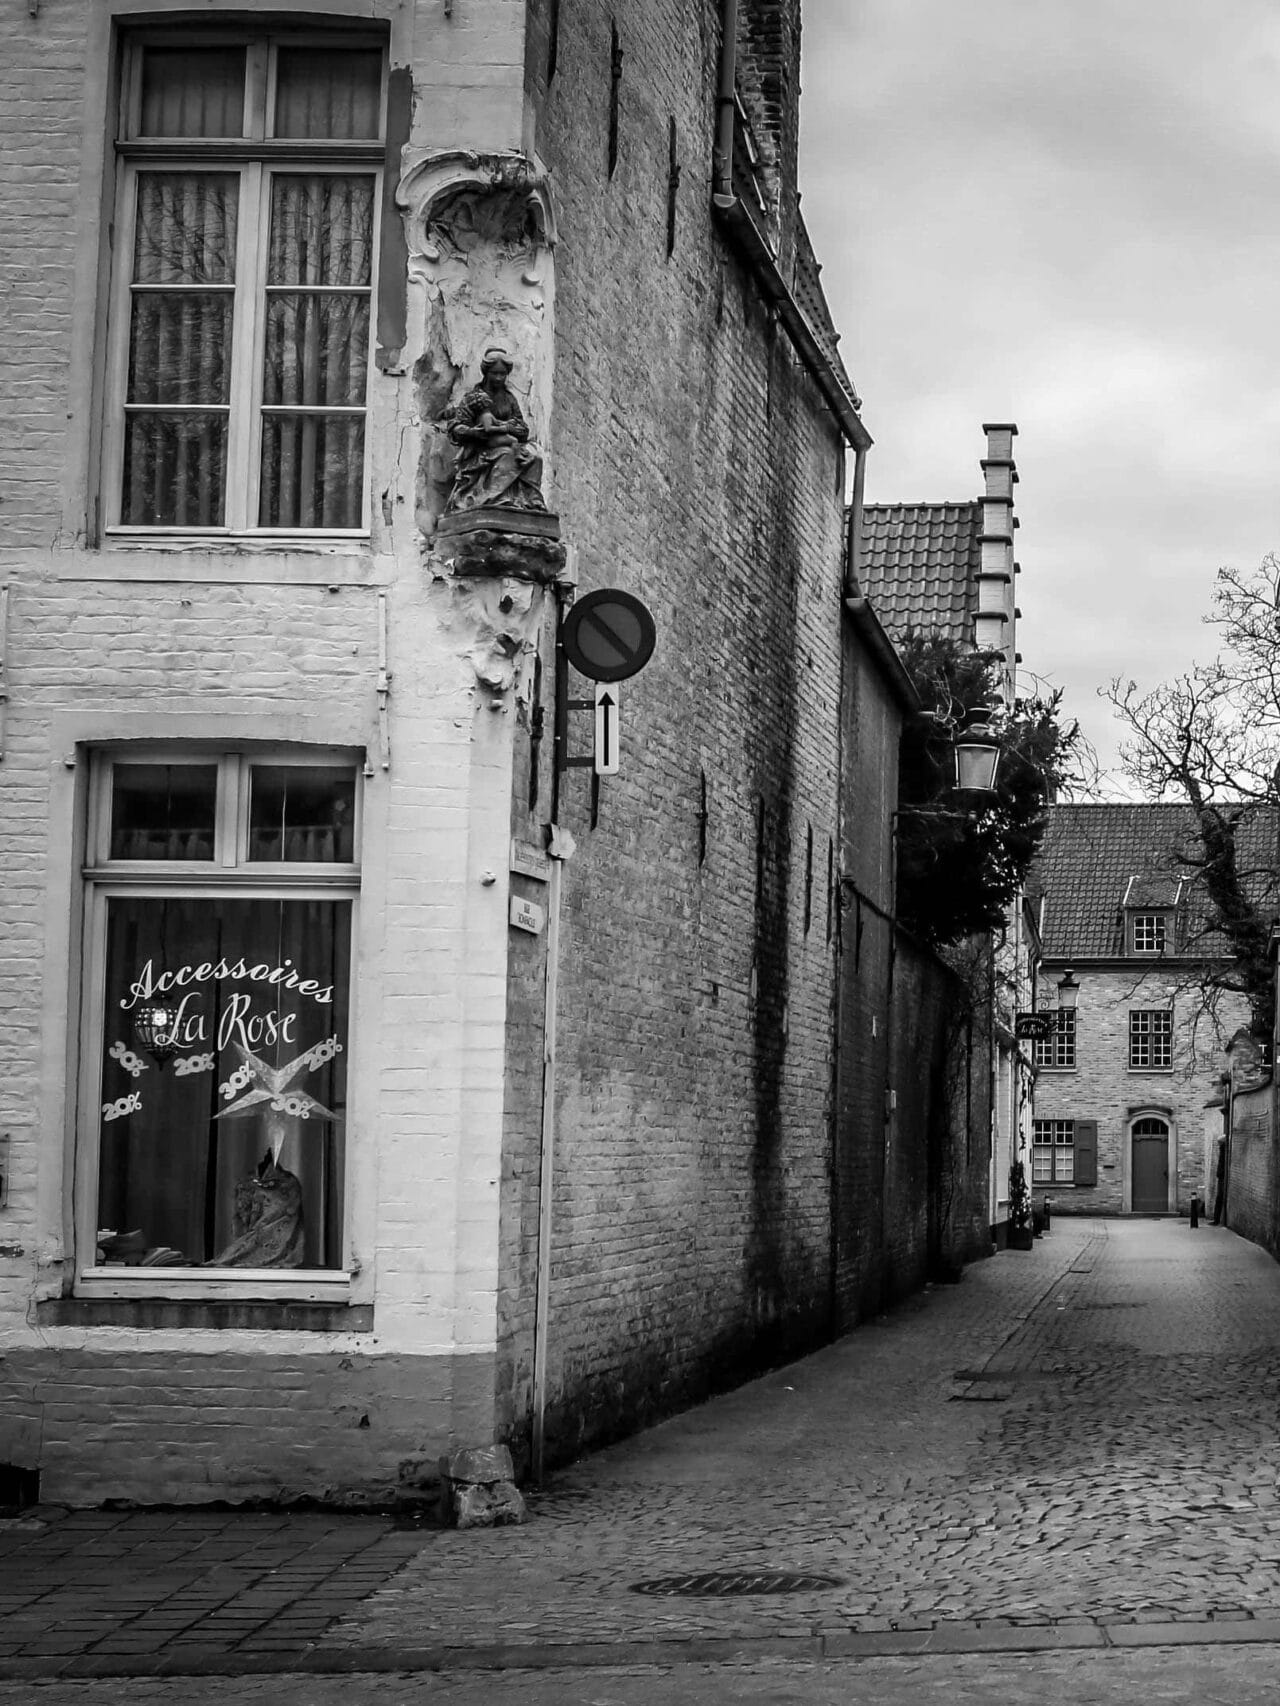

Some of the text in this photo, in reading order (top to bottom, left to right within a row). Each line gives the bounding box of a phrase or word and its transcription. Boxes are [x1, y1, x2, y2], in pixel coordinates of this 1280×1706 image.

[120, 957, 334, 1010] Accessoires
[154, 992, 297, 1053] La Rose
[109, 1041, 149, 1077] 30%
[173, 1051, 216, 1076] 20%
[303, 1033, 343, 1072] 20%
[218, 1060, 256, 1100] 30%
[102, 1091, 142, 1122] 20%
[270, 1093, 317, 1119] 30%
